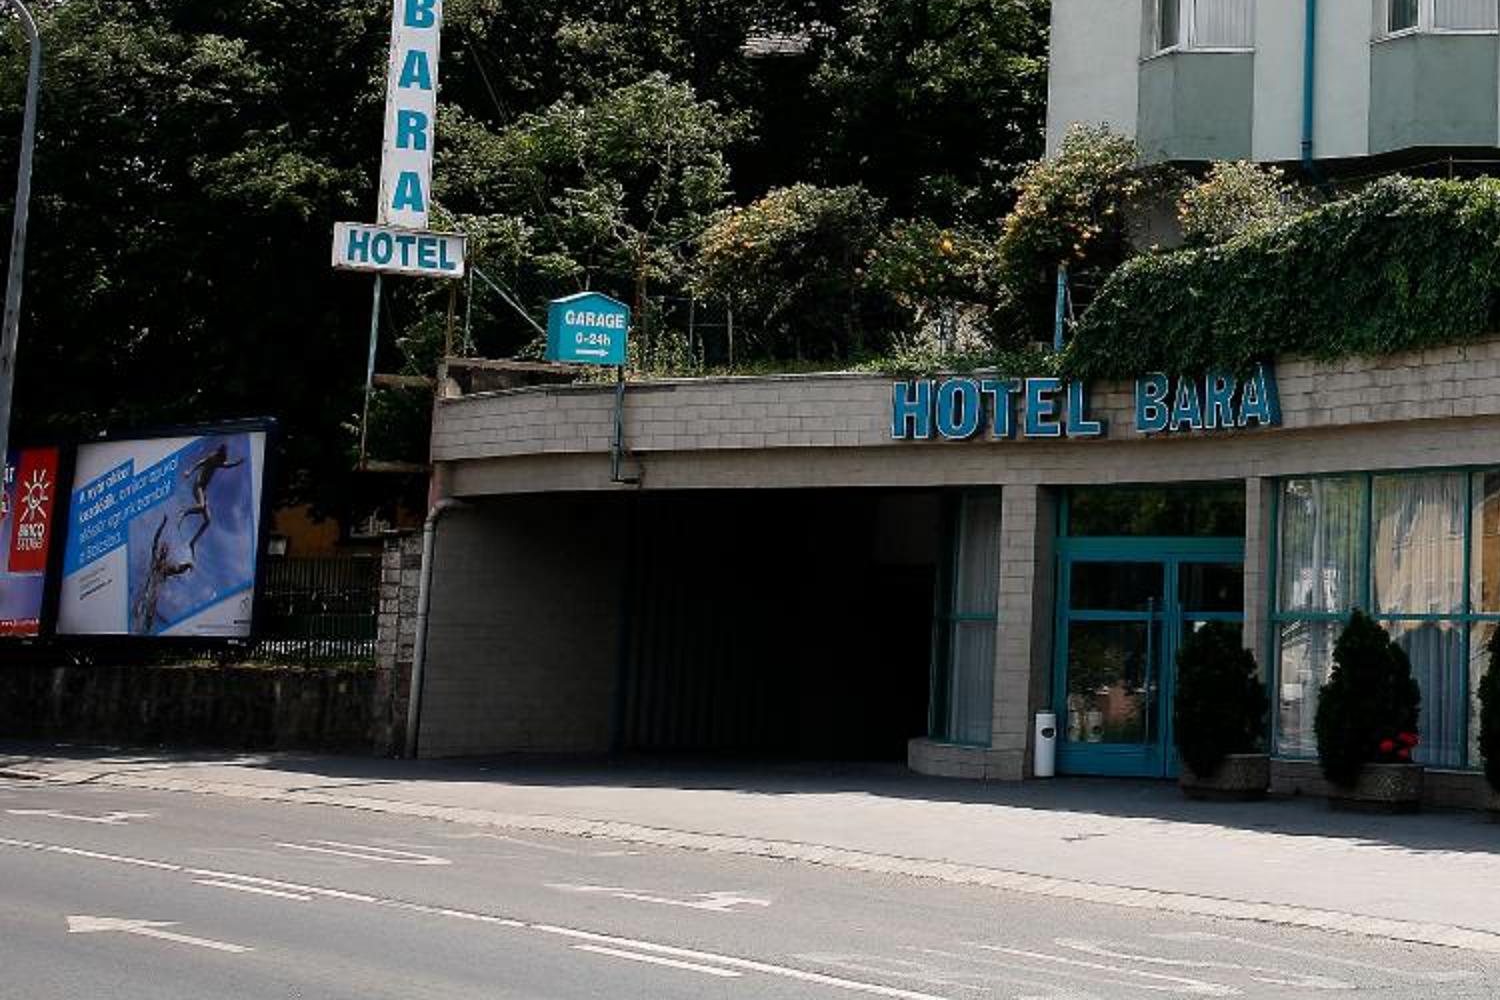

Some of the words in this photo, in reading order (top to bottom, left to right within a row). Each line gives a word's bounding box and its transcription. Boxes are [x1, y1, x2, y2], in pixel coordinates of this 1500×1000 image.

[346, 229, 457, 271] HOTEL
[565, 310, 625, 329] GARAGE
[891, 377, 1104, 440] HOTEL
[1134, 362, 1282, 434] BARA
